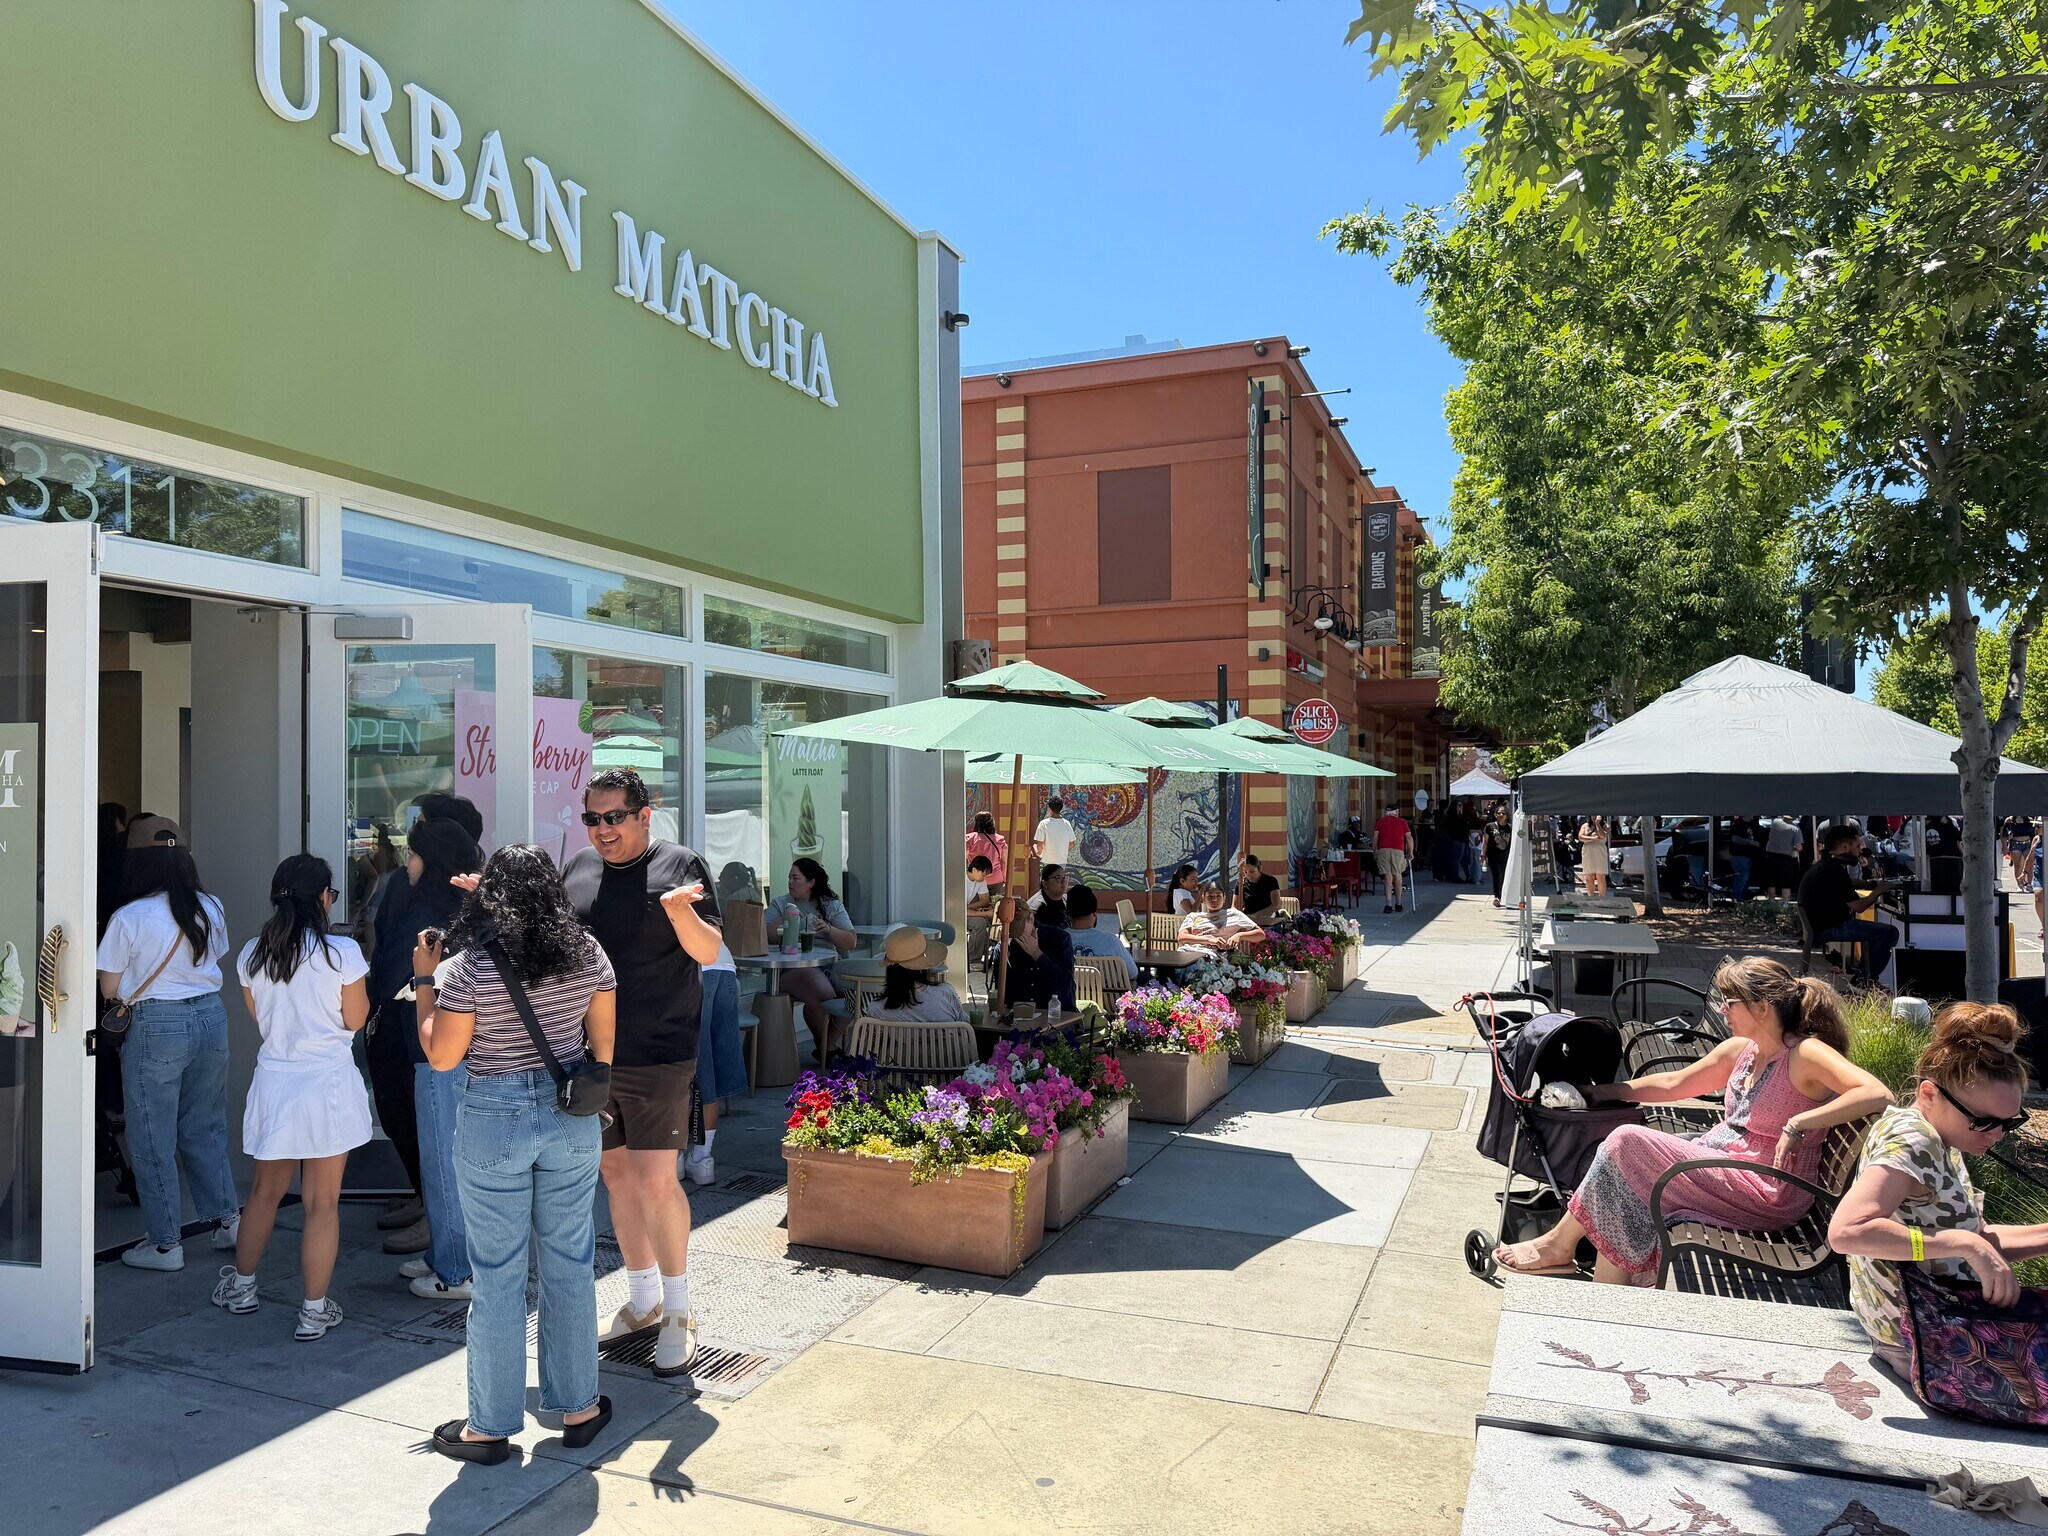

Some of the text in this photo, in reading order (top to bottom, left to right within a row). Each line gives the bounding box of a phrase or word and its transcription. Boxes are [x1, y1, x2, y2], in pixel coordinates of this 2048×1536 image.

[254, 0, 839, 407] URBAN MATCHA
[5, 441, 175, 542] 3311
[1371, 551, 1386, 590] BARONS
[1420, 592, 1432, 638] AMPHORA
[1299, 705, 1329, 718] SLICE
[460, 719, 588, 790] Strberry
[777, 735, 837, 762] Matcha
[540, 781, 560, 794] CAP
[792, 768, 823, 776] LATTE FLOAT
[692, 1089, 701, 1142] lululemon
